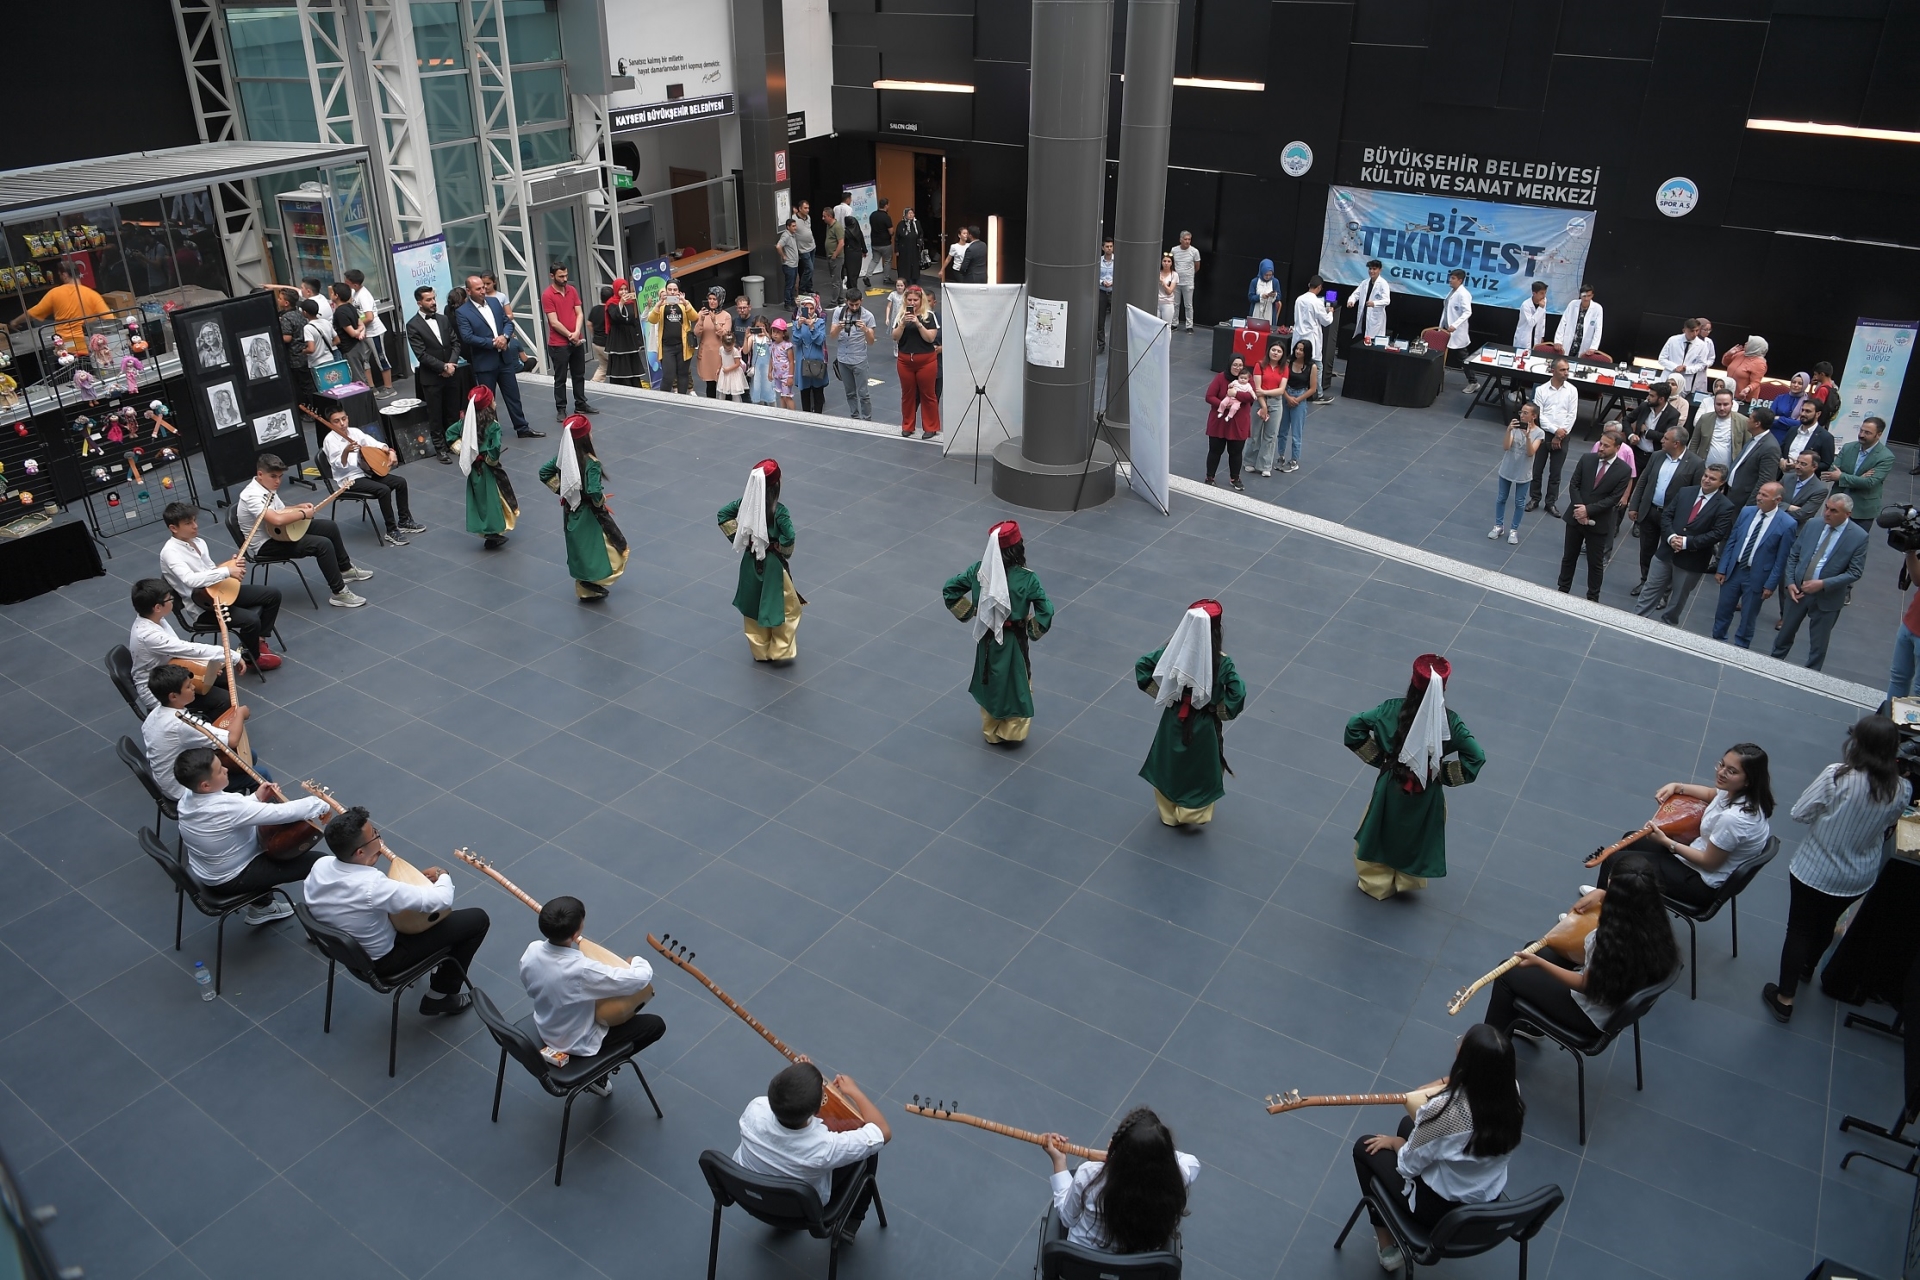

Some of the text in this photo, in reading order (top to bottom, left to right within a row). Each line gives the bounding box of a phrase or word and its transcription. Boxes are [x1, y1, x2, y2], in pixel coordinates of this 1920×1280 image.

[637, 66, 650, 75] hayat
[615, 99, 724, 126] KAYSERİ BÜYÜKŞEHİR BELEDİYESİ
[1363, 146, 1601, 185] BÜYÜKŞEHİR BELEDİYESİ
[1360, 165, 1597, 206] KÜLTÜR VE SANAT MERKEZİ
[1428, 207, 1478, 237] BİZ
[1360, 225, 1546, 278] TEKNOFEST
[1390, 265, 1500, 292] GENÇLİİYİZ
[1866, 343, 1894, 354] büyük
[1866, 352, 1891, 362] aileyiz
